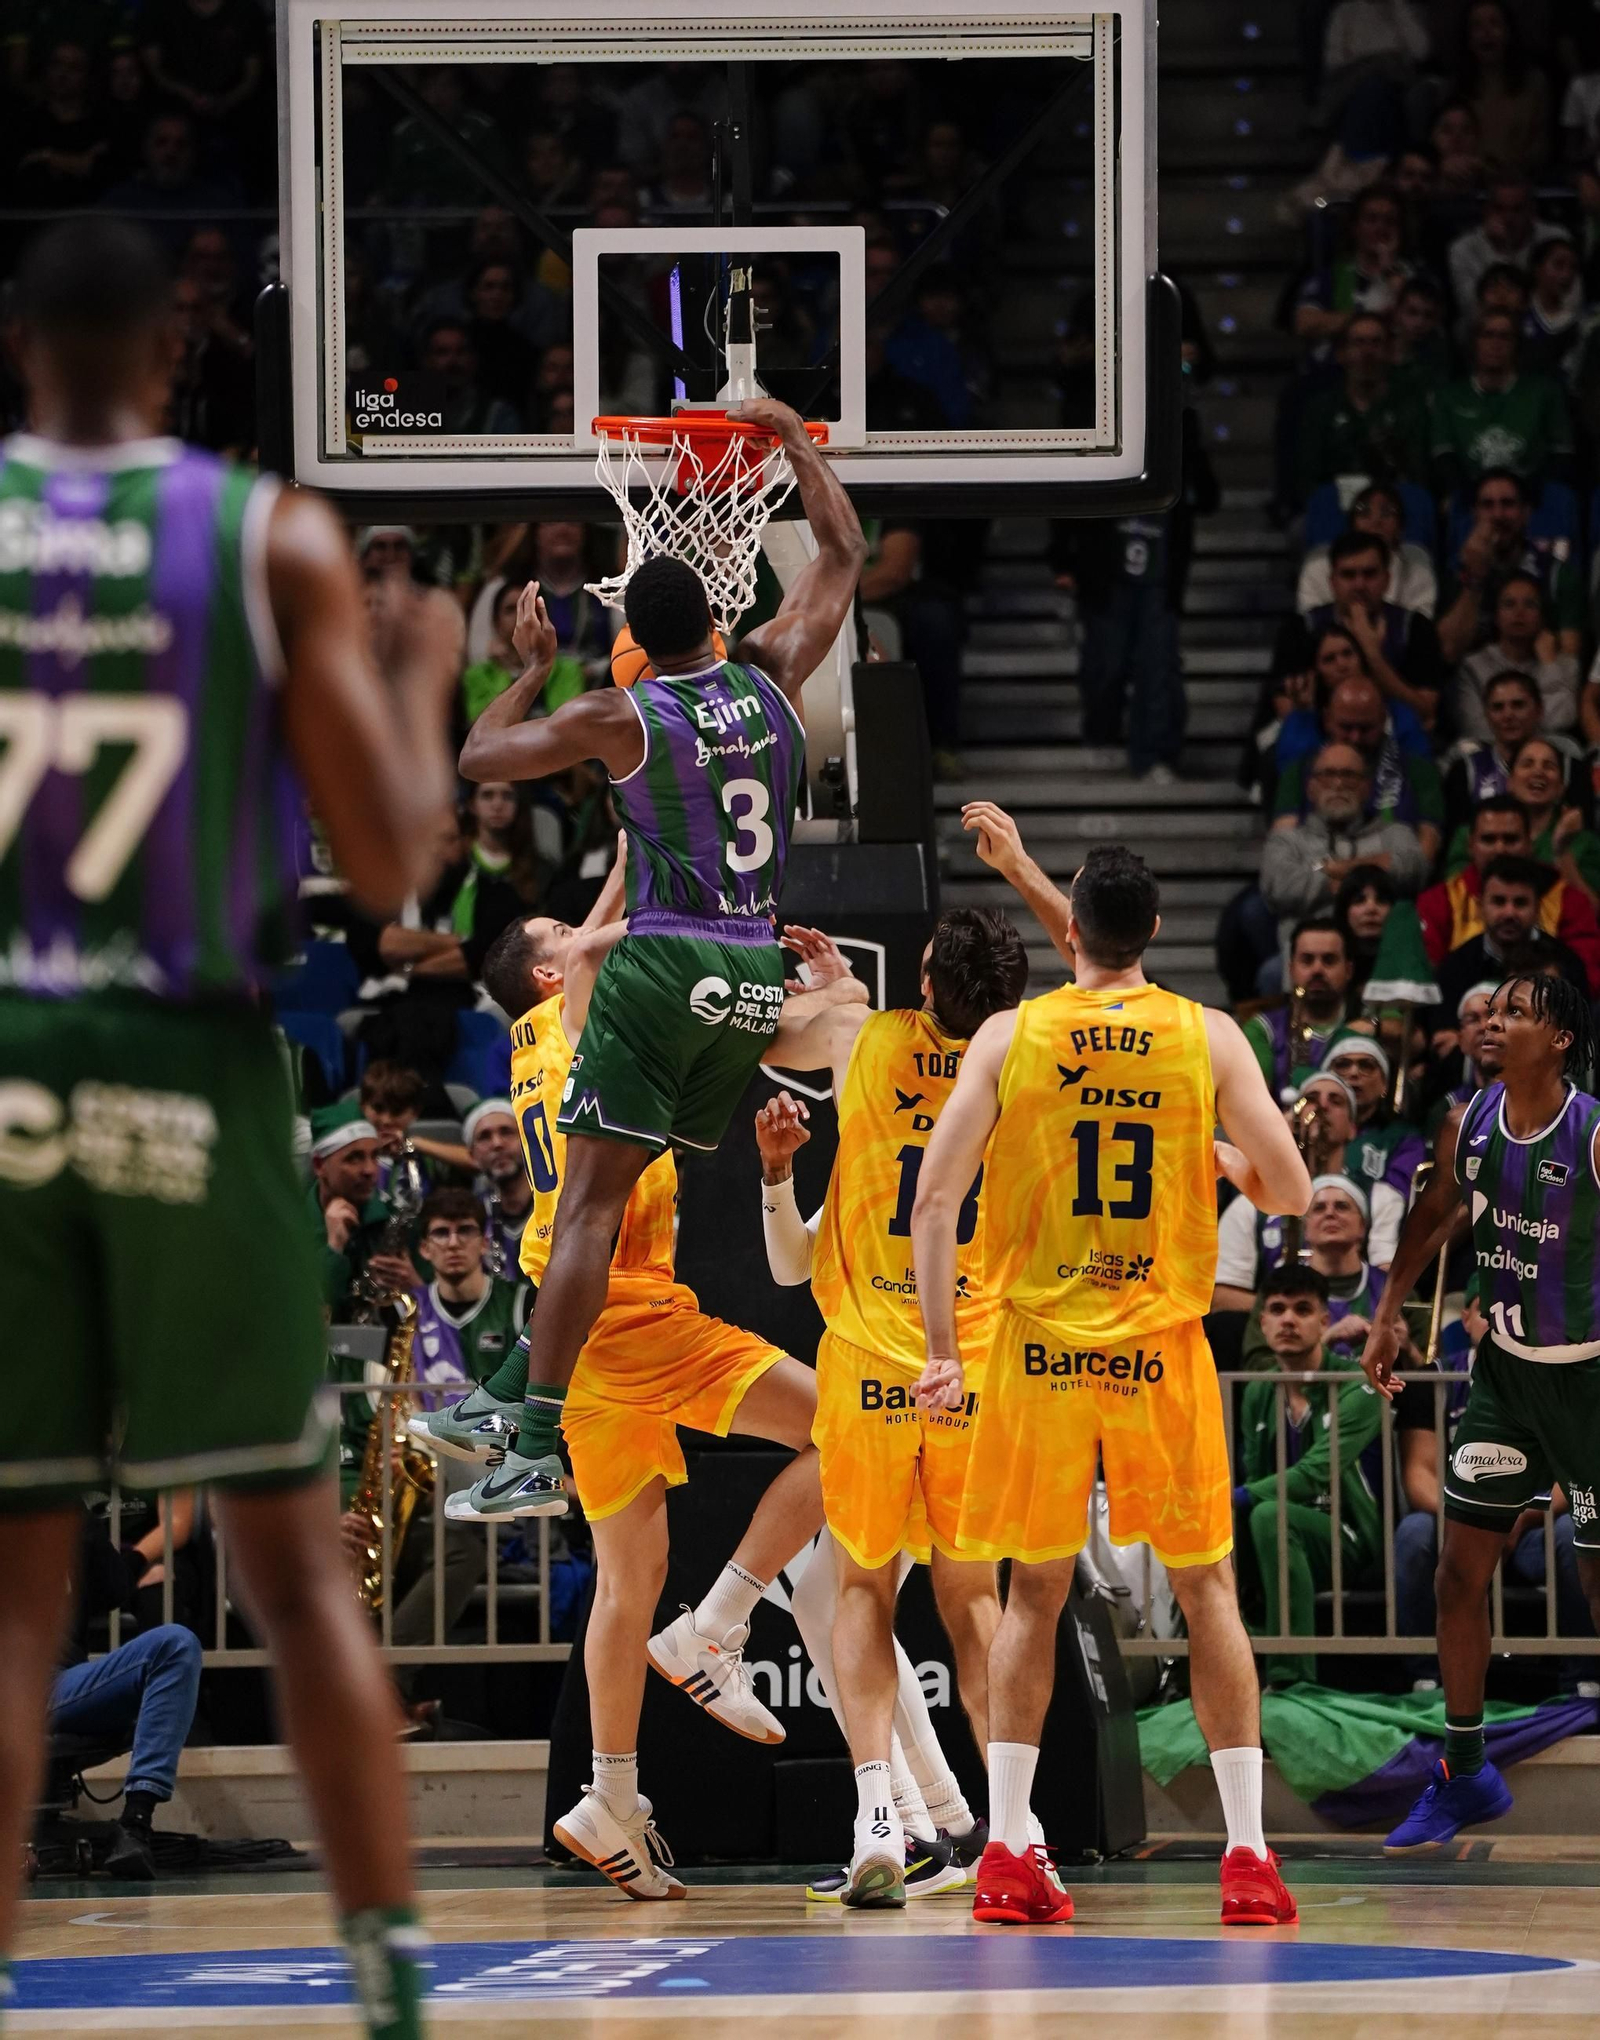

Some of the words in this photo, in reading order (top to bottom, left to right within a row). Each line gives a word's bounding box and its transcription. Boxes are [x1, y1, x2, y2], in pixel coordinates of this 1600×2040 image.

[355, 389, 395, 411] liga
[355, 408, 442, 428] endesa
[693, 694, 761, 735] Ejim
[0, 690, 190, 903] 77
[721, 778, 774, 873] 3
[739, 981, 784, 1004] COSTA
[735, 1000, 764, 1018] DEL
[1070, 1026, 1154, 1056] PELOS
[912, 1053, 958, 1079] TOB
[1069, 1120, 1155, 1220] 13
[1492, 1207, 1560, 1245] Unicaja
[1089, 1249, 1125, 1268] Islas
[1489, 1301, 1526, 1338] 11
[1024, 1343, 1165, 1384] Barceló
[1050, 1378, 1092, 1392] HOTEL
